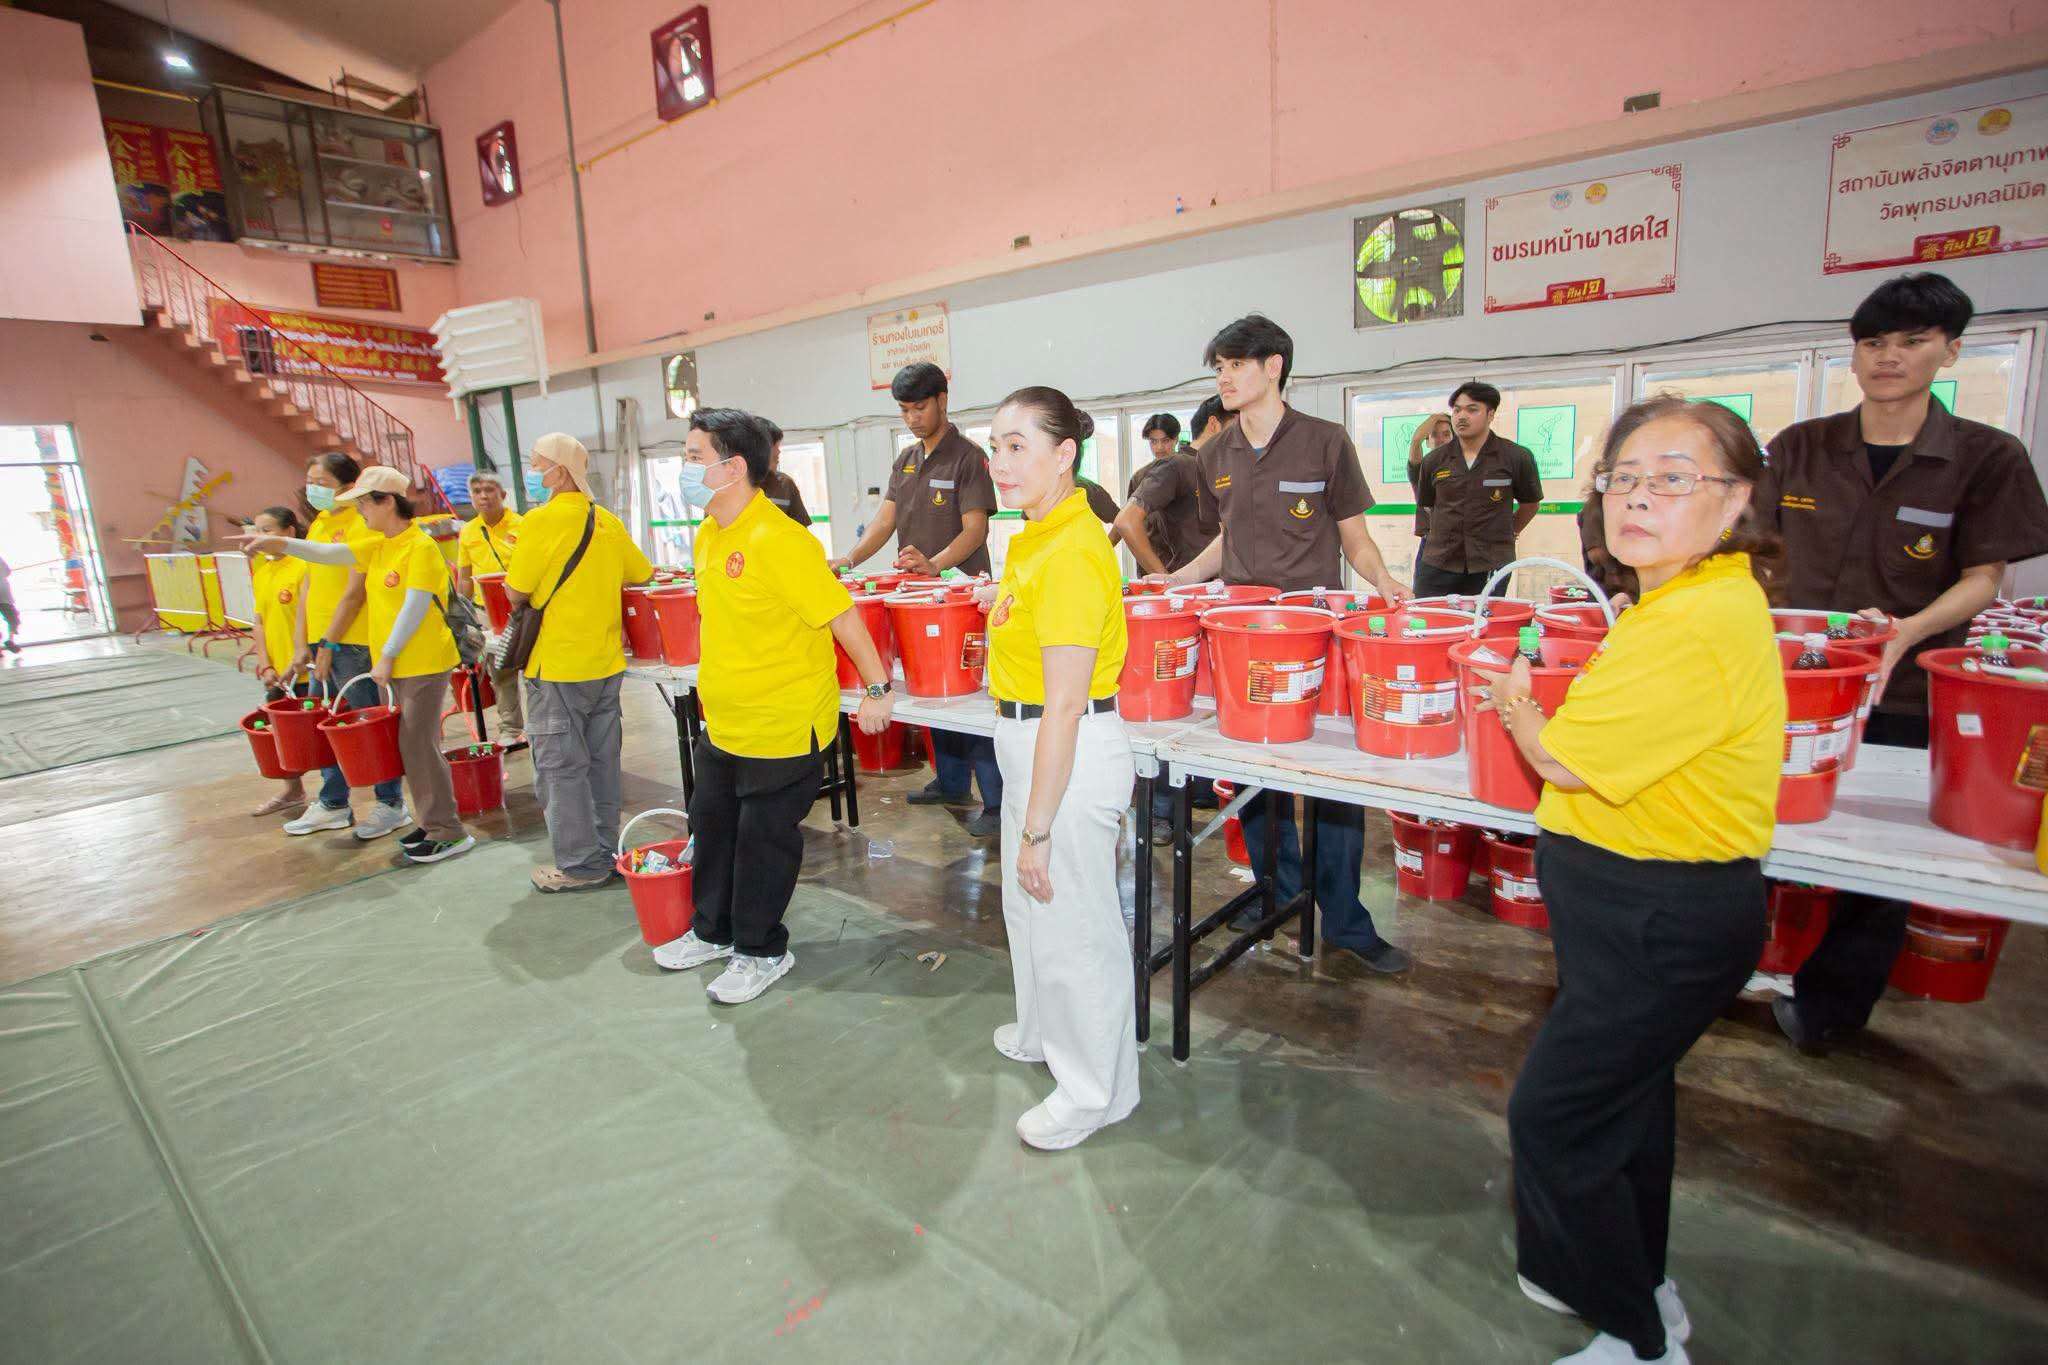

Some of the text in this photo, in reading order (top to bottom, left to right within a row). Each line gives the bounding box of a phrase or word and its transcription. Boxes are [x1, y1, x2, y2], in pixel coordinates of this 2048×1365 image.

[1880, 180, 2047, 222] วัดพุทธมงคลนิมิต
[1492, 214, 1670, 262] ชมรมหน้าผาสดใส
